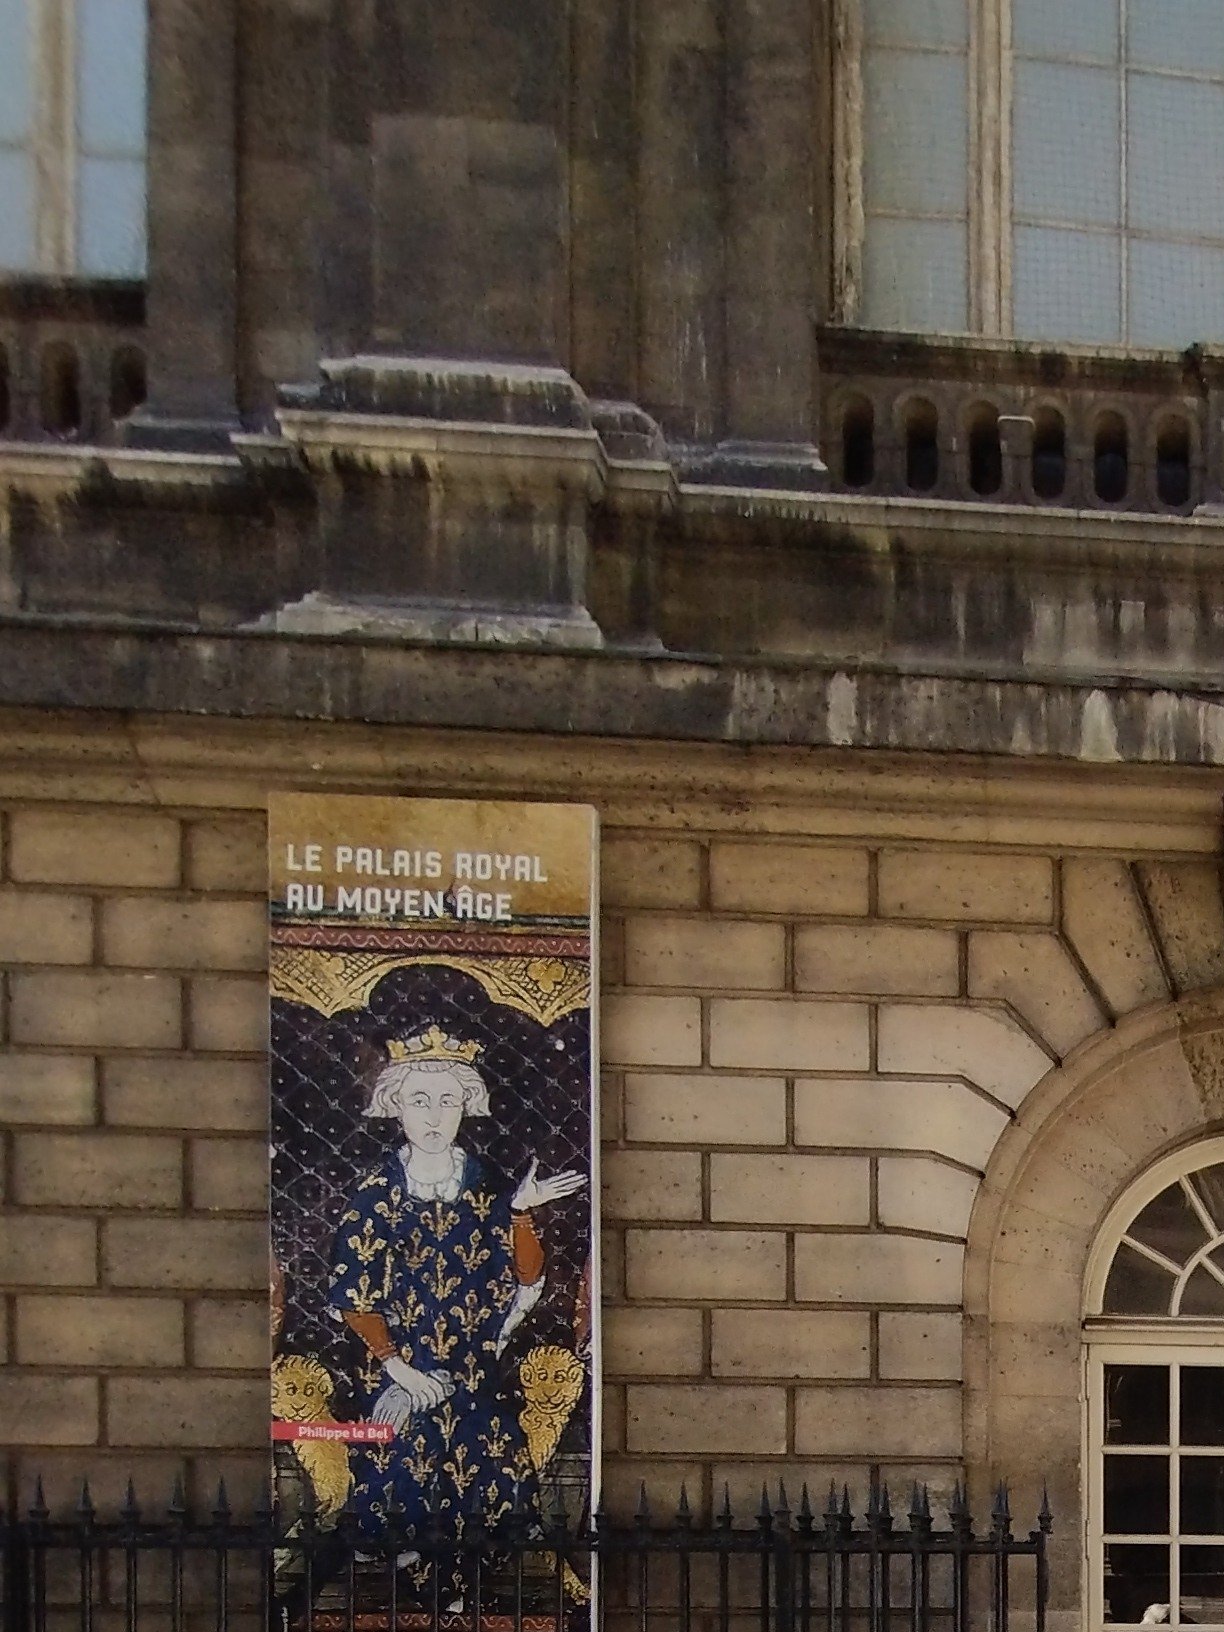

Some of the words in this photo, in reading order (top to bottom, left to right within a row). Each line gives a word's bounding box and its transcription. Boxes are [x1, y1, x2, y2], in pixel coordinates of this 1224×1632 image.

[286, 843, 323, 872] LE
[335, 846, 442, 877] PALAIS
[456, 853, 548, 882] ROYAL
[286, 883, 324, 912] AU
[337, 886, 444, 917] MOYEN
[456, 885, 512, 920] ÂGE
[298, 1426, 350, 1440] Philippe
[352, 1427, 365, 1438] le
[367, 1428, 388, 1439] Bel
